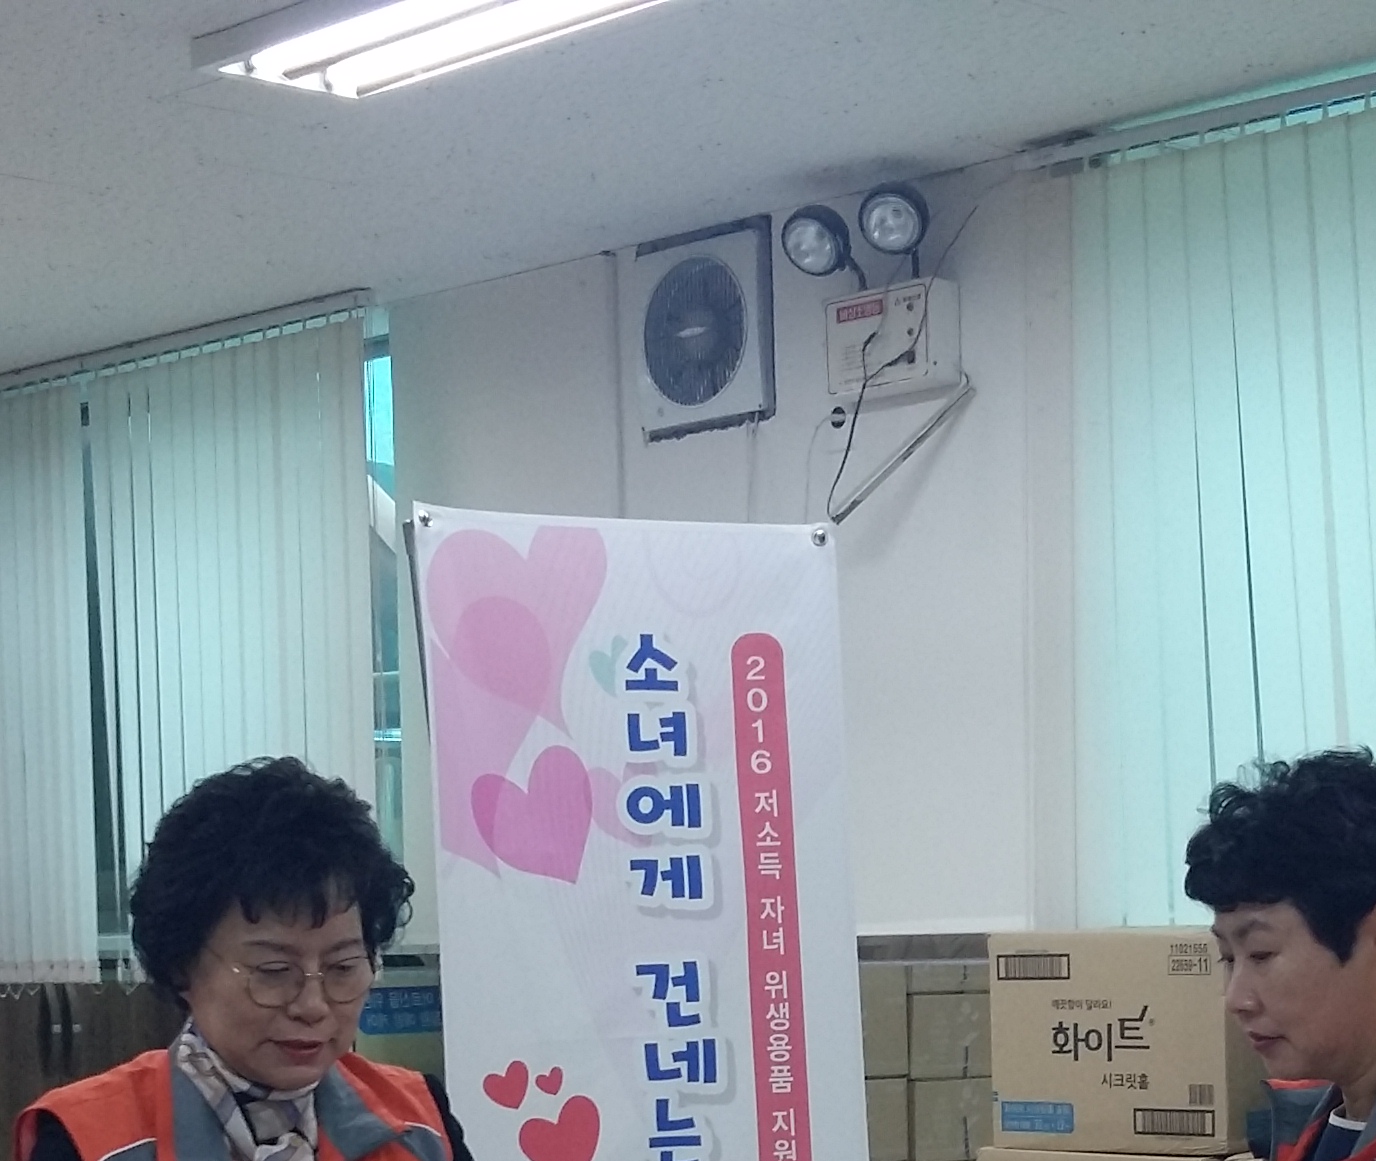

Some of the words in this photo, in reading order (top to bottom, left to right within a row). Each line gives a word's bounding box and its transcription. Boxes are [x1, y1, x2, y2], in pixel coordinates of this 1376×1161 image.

[745, 655, 773, 775] 2016
[625, 633, 703, 901] 소녀에게
[754, 788, 783, 880] 저소득
[759, 895, 786, 955] 자녀
[763, 969, 794, 1093] 위생용품
[1051, 1005, 1151, 1062] 화이트
[1101, 1073, 1150, 1091] 시크릿홀
